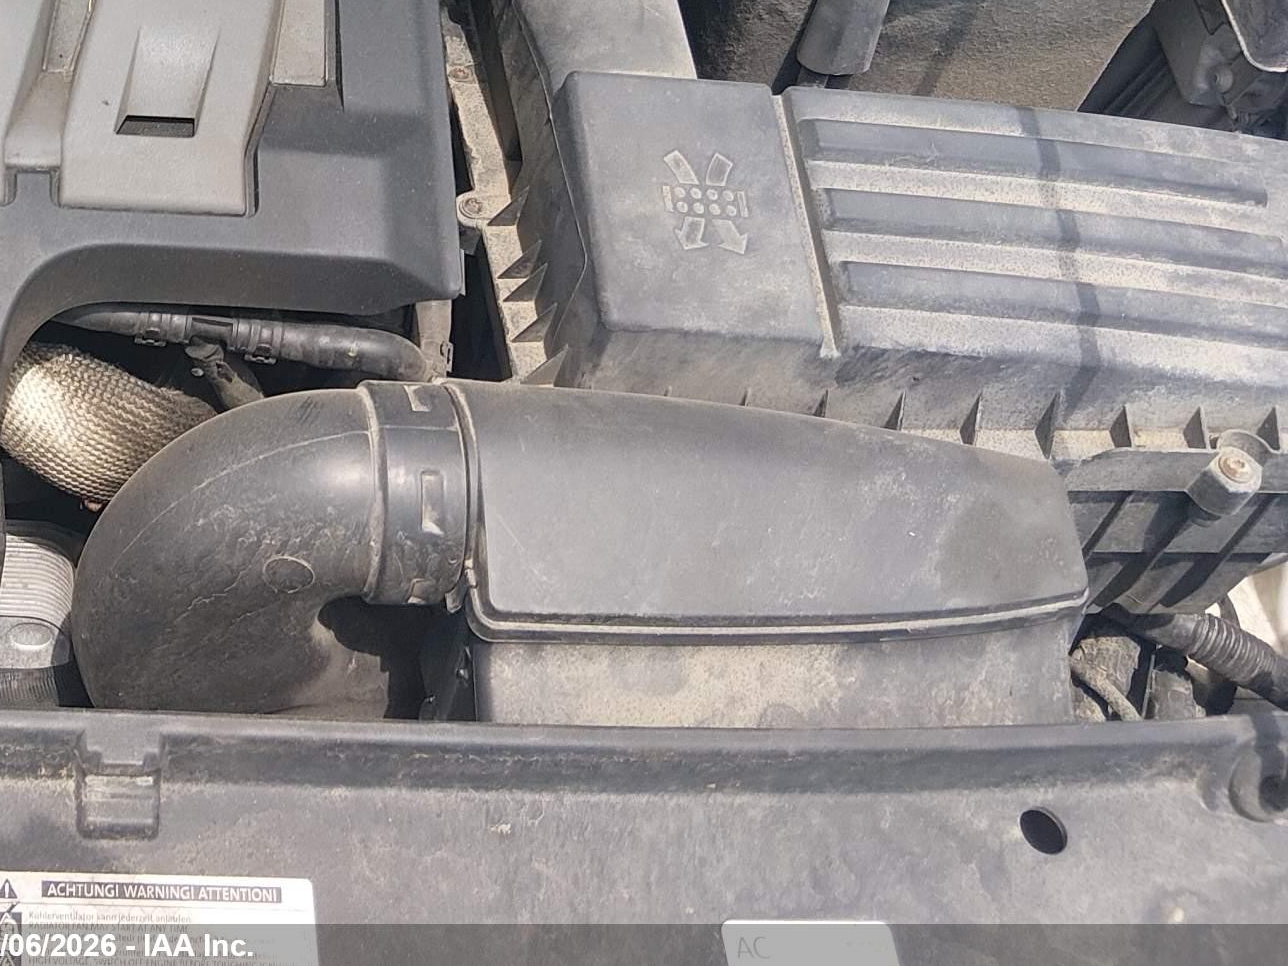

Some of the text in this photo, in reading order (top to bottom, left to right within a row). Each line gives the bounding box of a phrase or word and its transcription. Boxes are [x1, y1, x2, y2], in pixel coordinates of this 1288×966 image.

[47, 883, 277, 902] ACHTUNG! WARNING! ATTENTION!
[150, 924, 167, 932] ANY
[737, 936, 770, 959] AC
